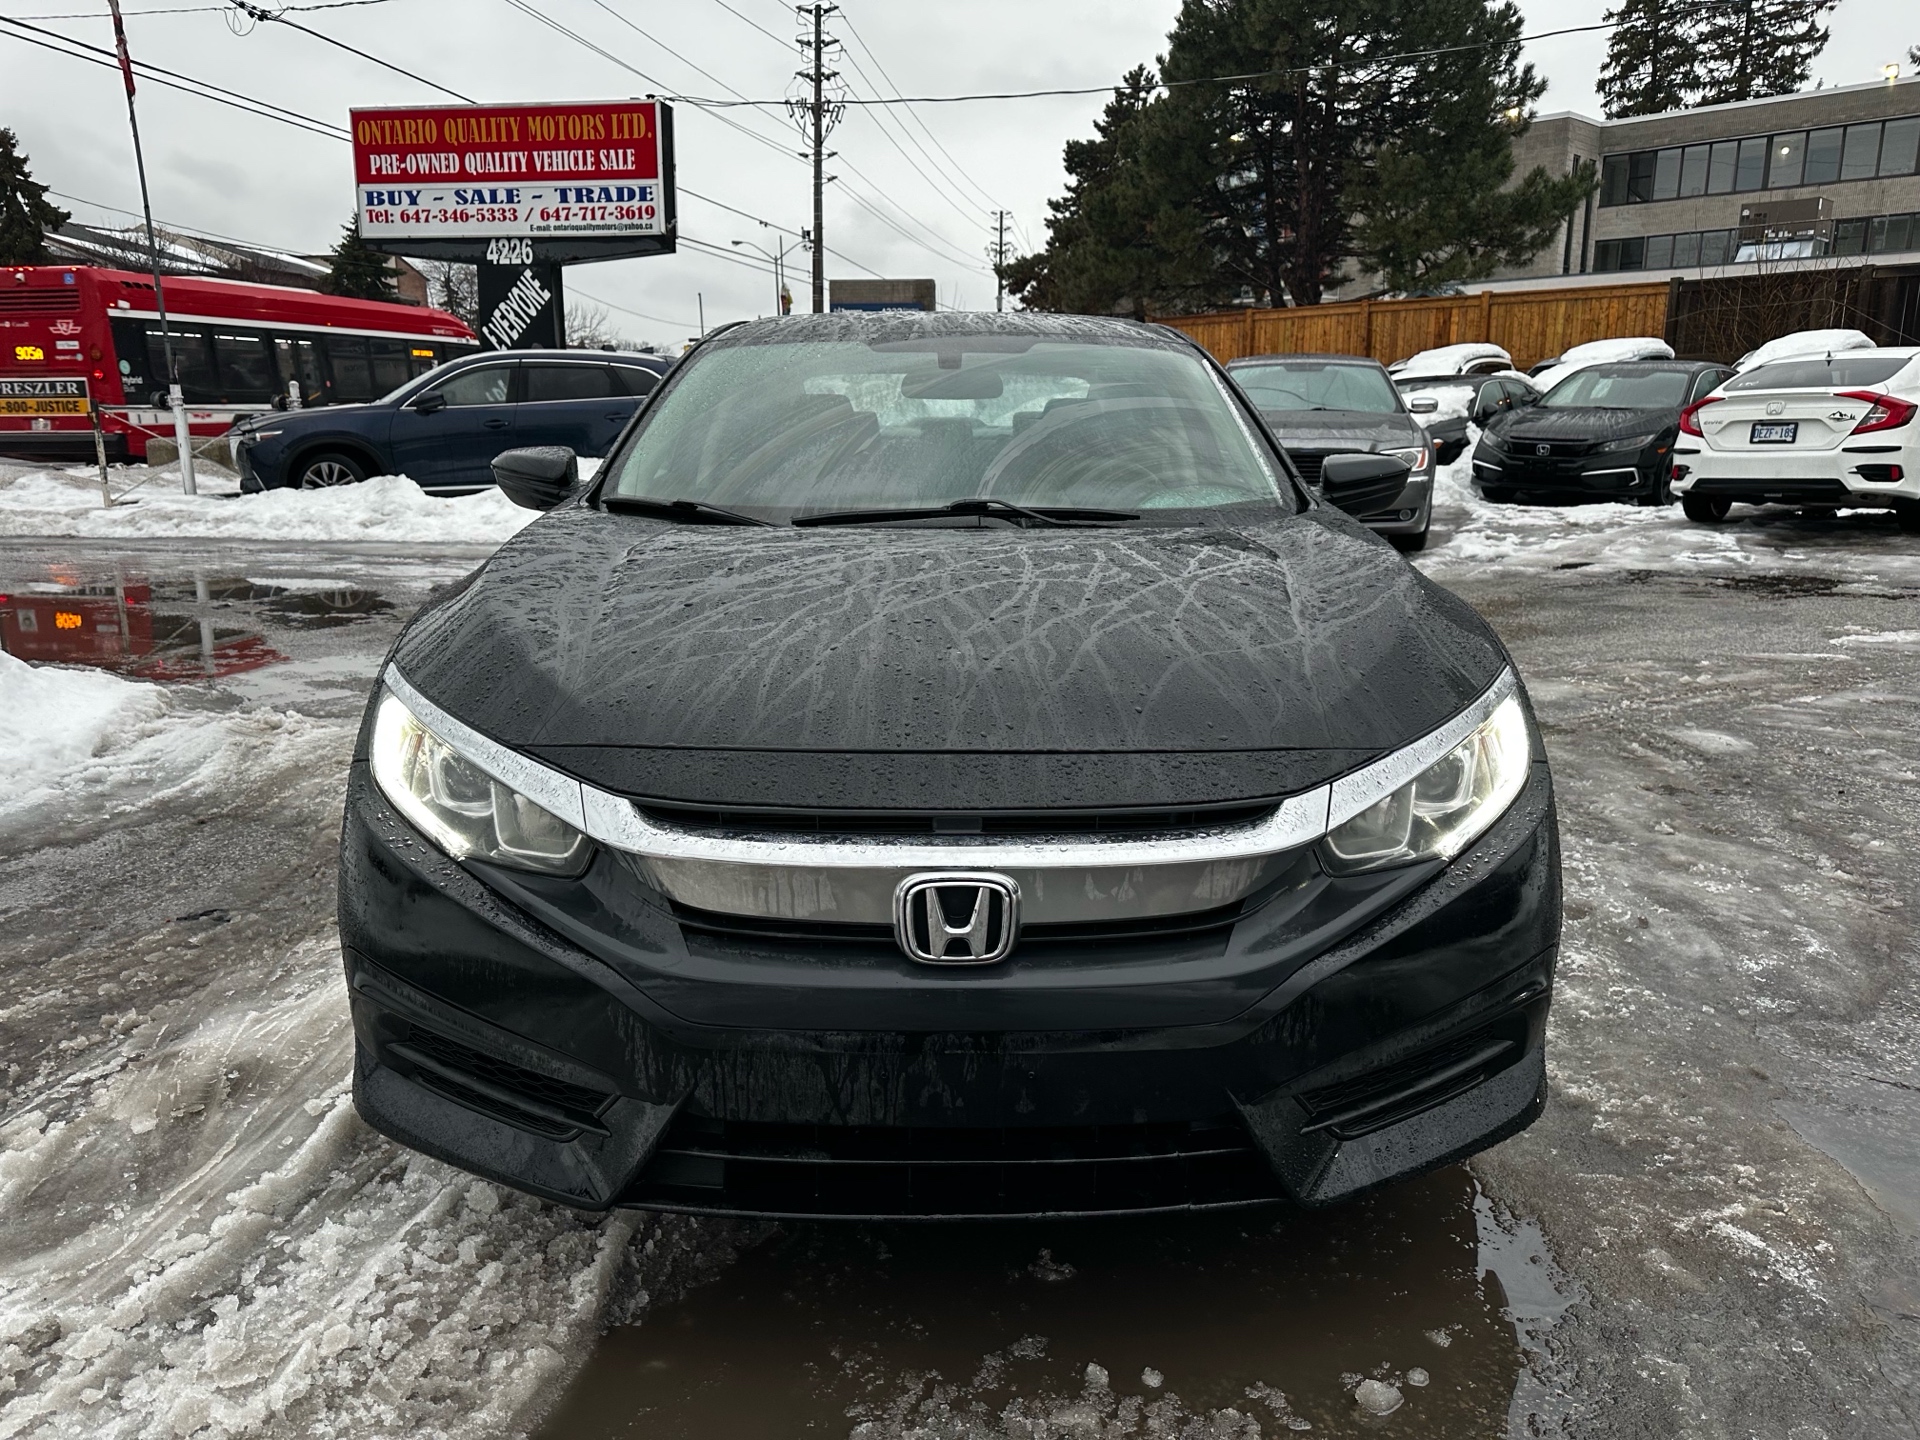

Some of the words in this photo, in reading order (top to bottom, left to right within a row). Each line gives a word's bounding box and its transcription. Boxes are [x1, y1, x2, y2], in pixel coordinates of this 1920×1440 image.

[357, 118, 438, 146] ONTARIO
[444, 115, 520, 144] QUALITY
[527, 113, 606, 142] MOTORS
[611, 112, 653, 140] LTD.
[369, 153, 460, 175] PRE-OWNED
[465, 151, 529, 174] QUALITY
[532, 149, 595, 172] VEHICLE
[599, 148, 636, 171] SALE
[365, 189, 422, 206] BUY
[454, 188, 521, 205] SALE
[554, 185, 654, 204] TRADE
[365, 208, 395, 224] Tel:
[399, 206, 519, 224] 647-346-5333
[524, 206, 534, 222] /
[539, 204, 656, 221] 647-717-3619
[529, 223, 552, 232] E-mail:
[553, 222, 653, 232] ontarioqualitymotors@yahoo.ca
[486, 237, 533, 265] 4226
[481, 267, 552, 351] EVERYONE
[14, 346, 45, 361] 905A
[0, 381, 80, 395] RESZLER
[0, 400, 81, 413] -800-JUSTICE
